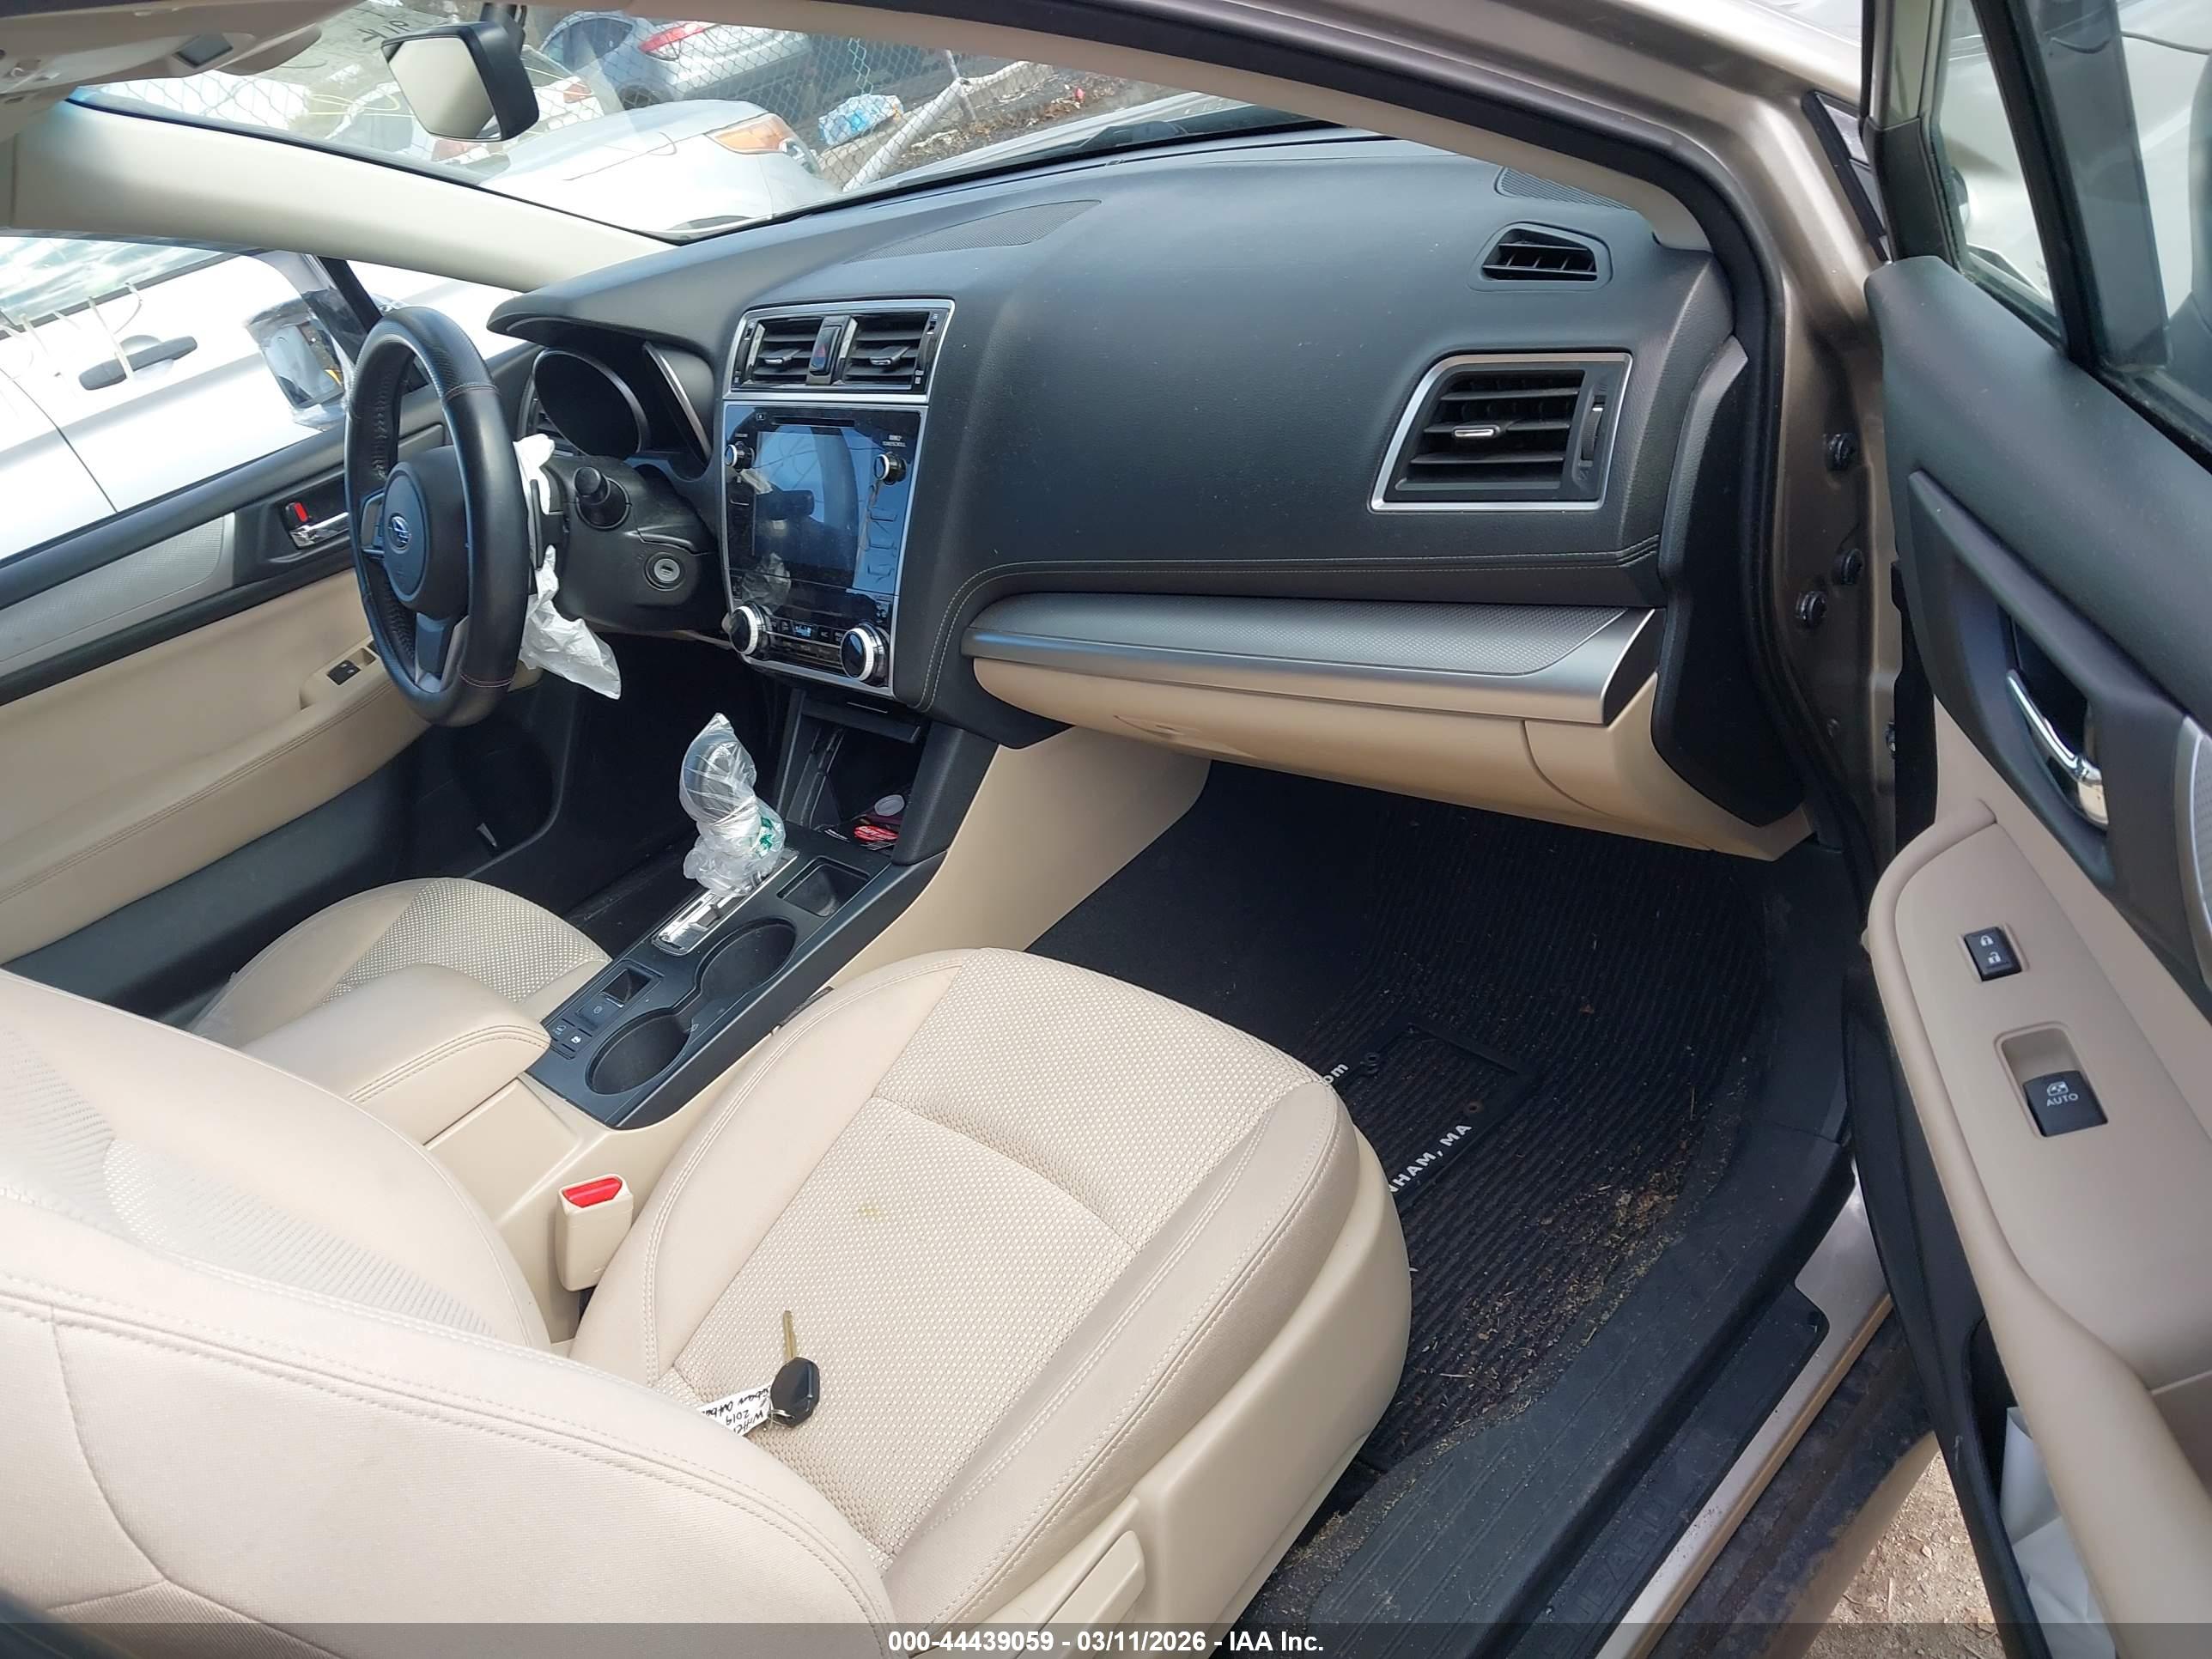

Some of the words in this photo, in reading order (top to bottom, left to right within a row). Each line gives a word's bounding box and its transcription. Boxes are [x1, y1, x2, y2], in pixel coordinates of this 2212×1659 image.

[2046, 1093, 2079, 1107] AUTO
[1439, 1125, 1473, 1147] MA
[702, 1401, 733, 1417] Outba
[726, 1409, 750, 1426] 2019
